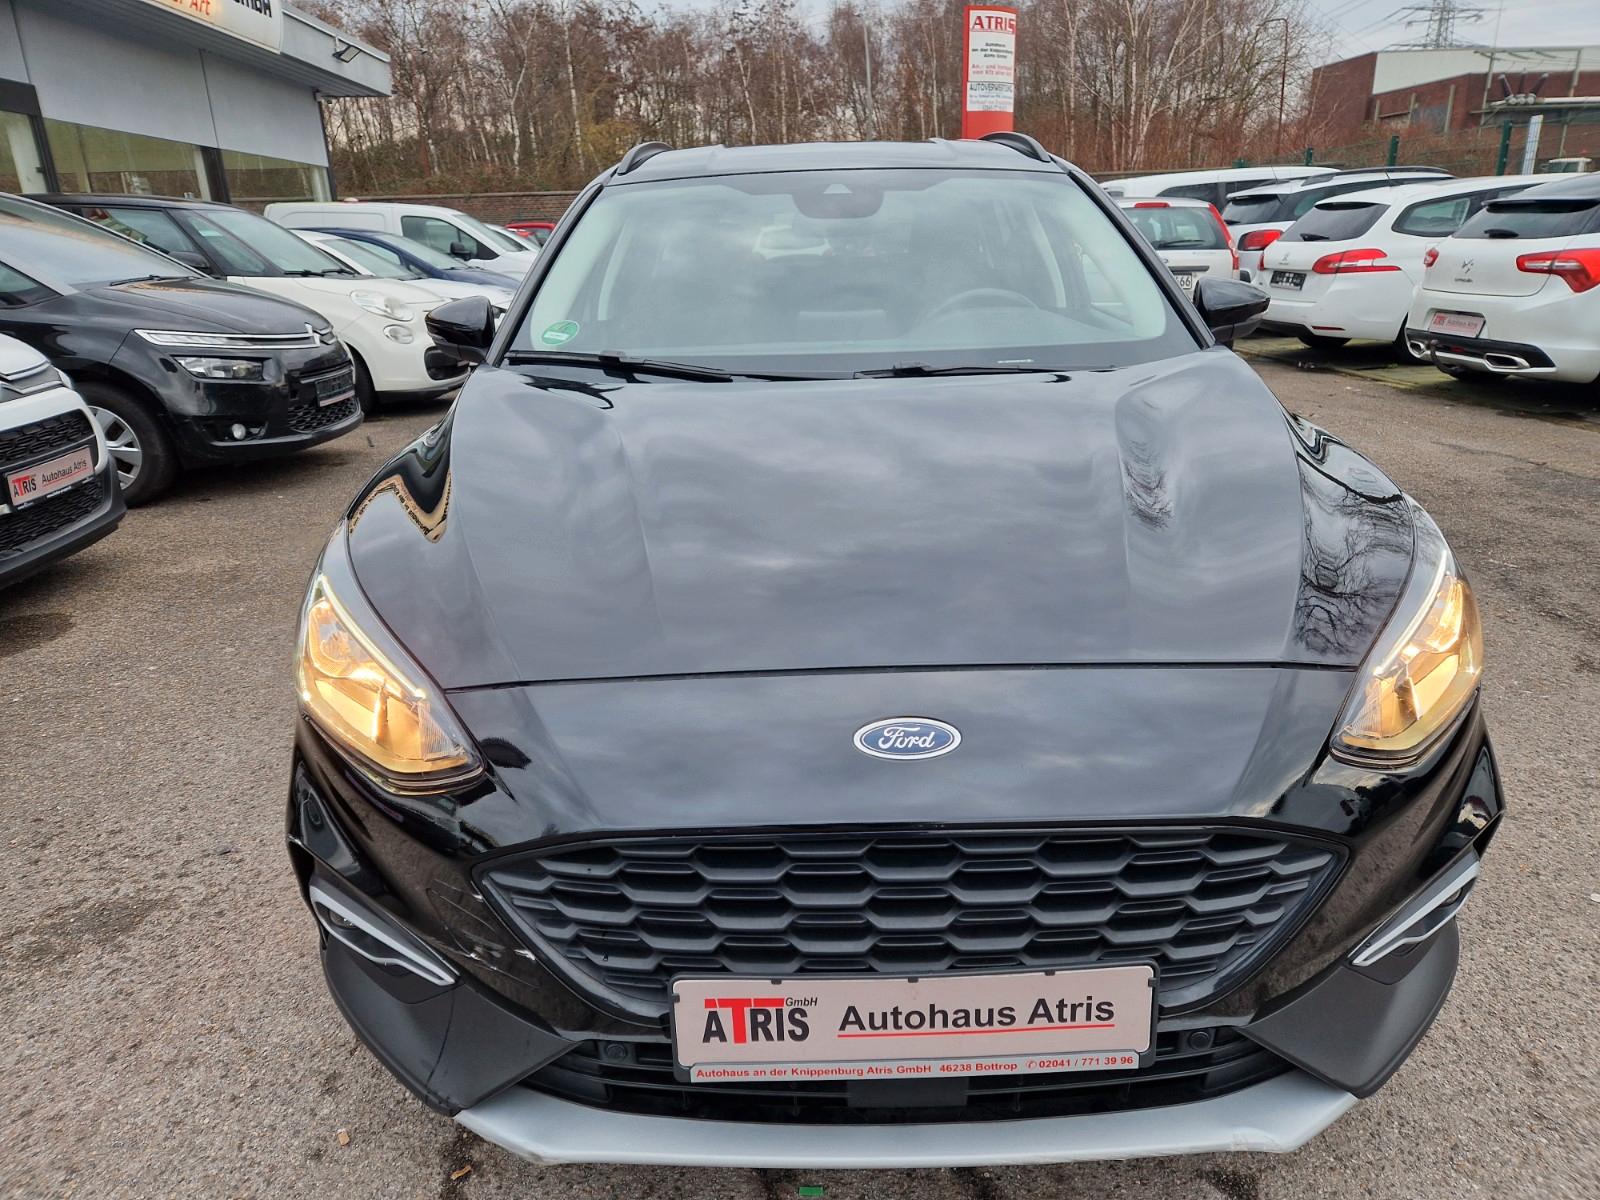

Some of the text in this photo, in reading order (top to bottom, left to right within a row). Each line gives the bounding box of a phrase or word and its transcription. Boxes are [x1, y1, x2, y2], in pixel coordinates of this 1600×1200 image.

[971, 15, 1016, 34] ATRIS
[41, 459, 88, 485] Autohaus Atris
[12, 474, 37, 498] ATRIS
[878, 726, 935, 749] Ford
[785, 996, 818, 1007] GmbH
[702, 995, 1115, 1044] ATRIS Autohaus Atris
[696, 1068, 750, 1078] Autohaus
[753, 1069, 767, 1077] an
[769, 1067, 788, 1076] der
[791, 1066, 864, 1077] Knippenburg
[867, 1065, 893, 1075] Atris
[896, 1064, 932, 1074] GmbH
[939, 1063, 972, 1073] 46238
[975, 1062, 1018, 1072] Bottrop
[1039, 1059, 1071, 1069] 02041
[1081, 1057, 1100, 1067] 771
[1103, 1056, 1117, 1066] 39
[1120, 1056, 1134, 1065] 96
